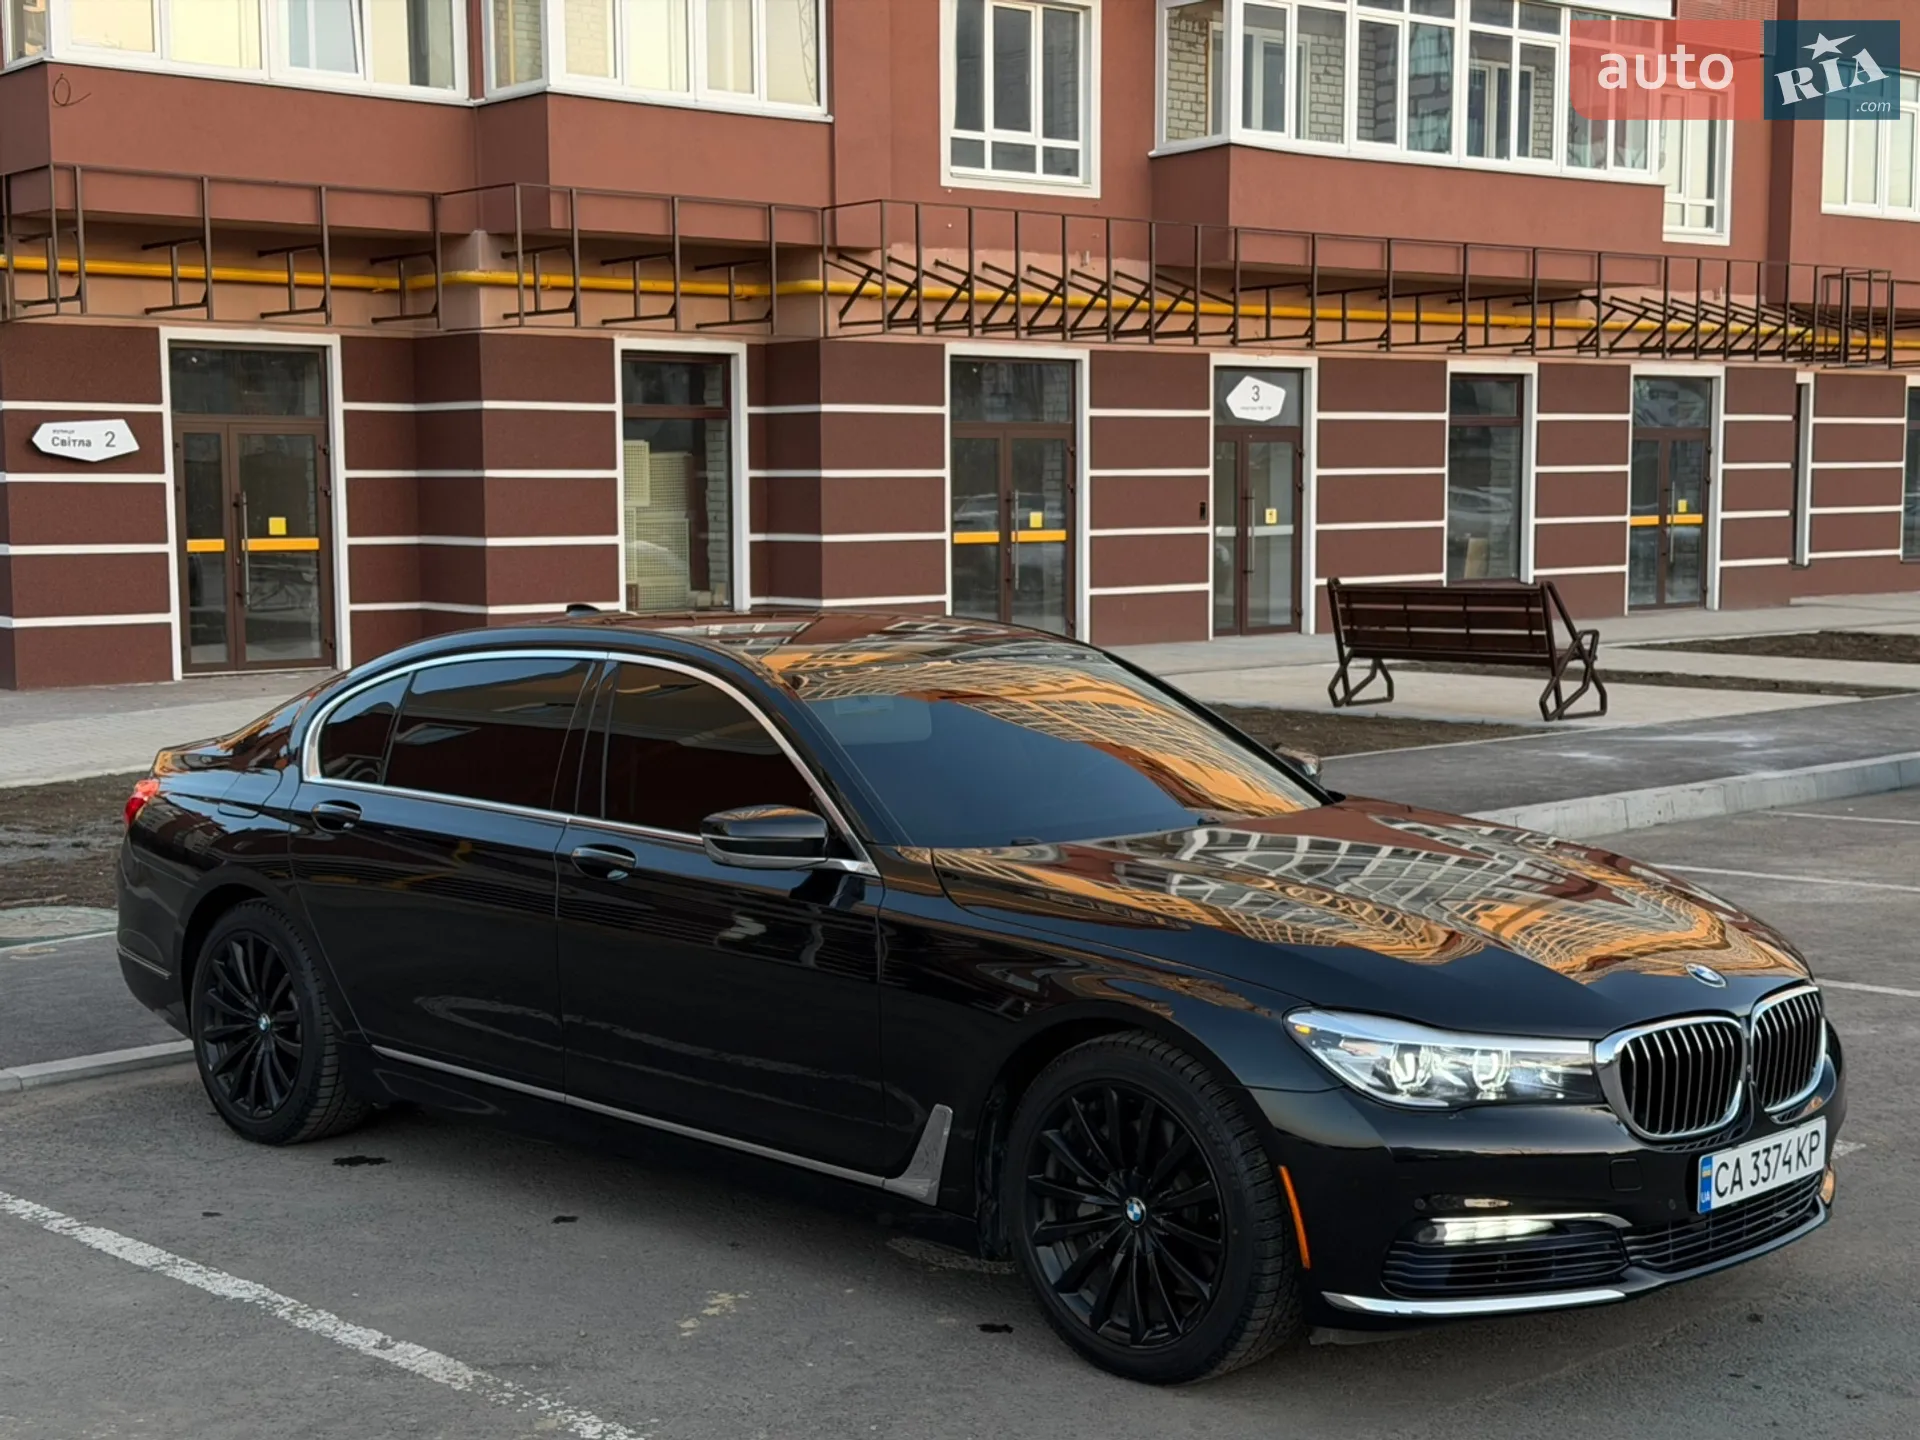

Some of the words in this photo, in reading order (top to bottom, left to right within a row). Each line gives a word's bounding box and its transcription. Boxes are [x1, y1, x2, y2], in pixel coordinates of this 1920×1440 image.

[1251, 385, 1260, 402] 3
[51, 436, 92, 448] Світла
[104, 430, 116, 448] 2
[1714, 1157, 1744, 1198] CA
[1750, 1139, 1792, 1187] 3374
[1796, 1130, 1821, 1171] KP
